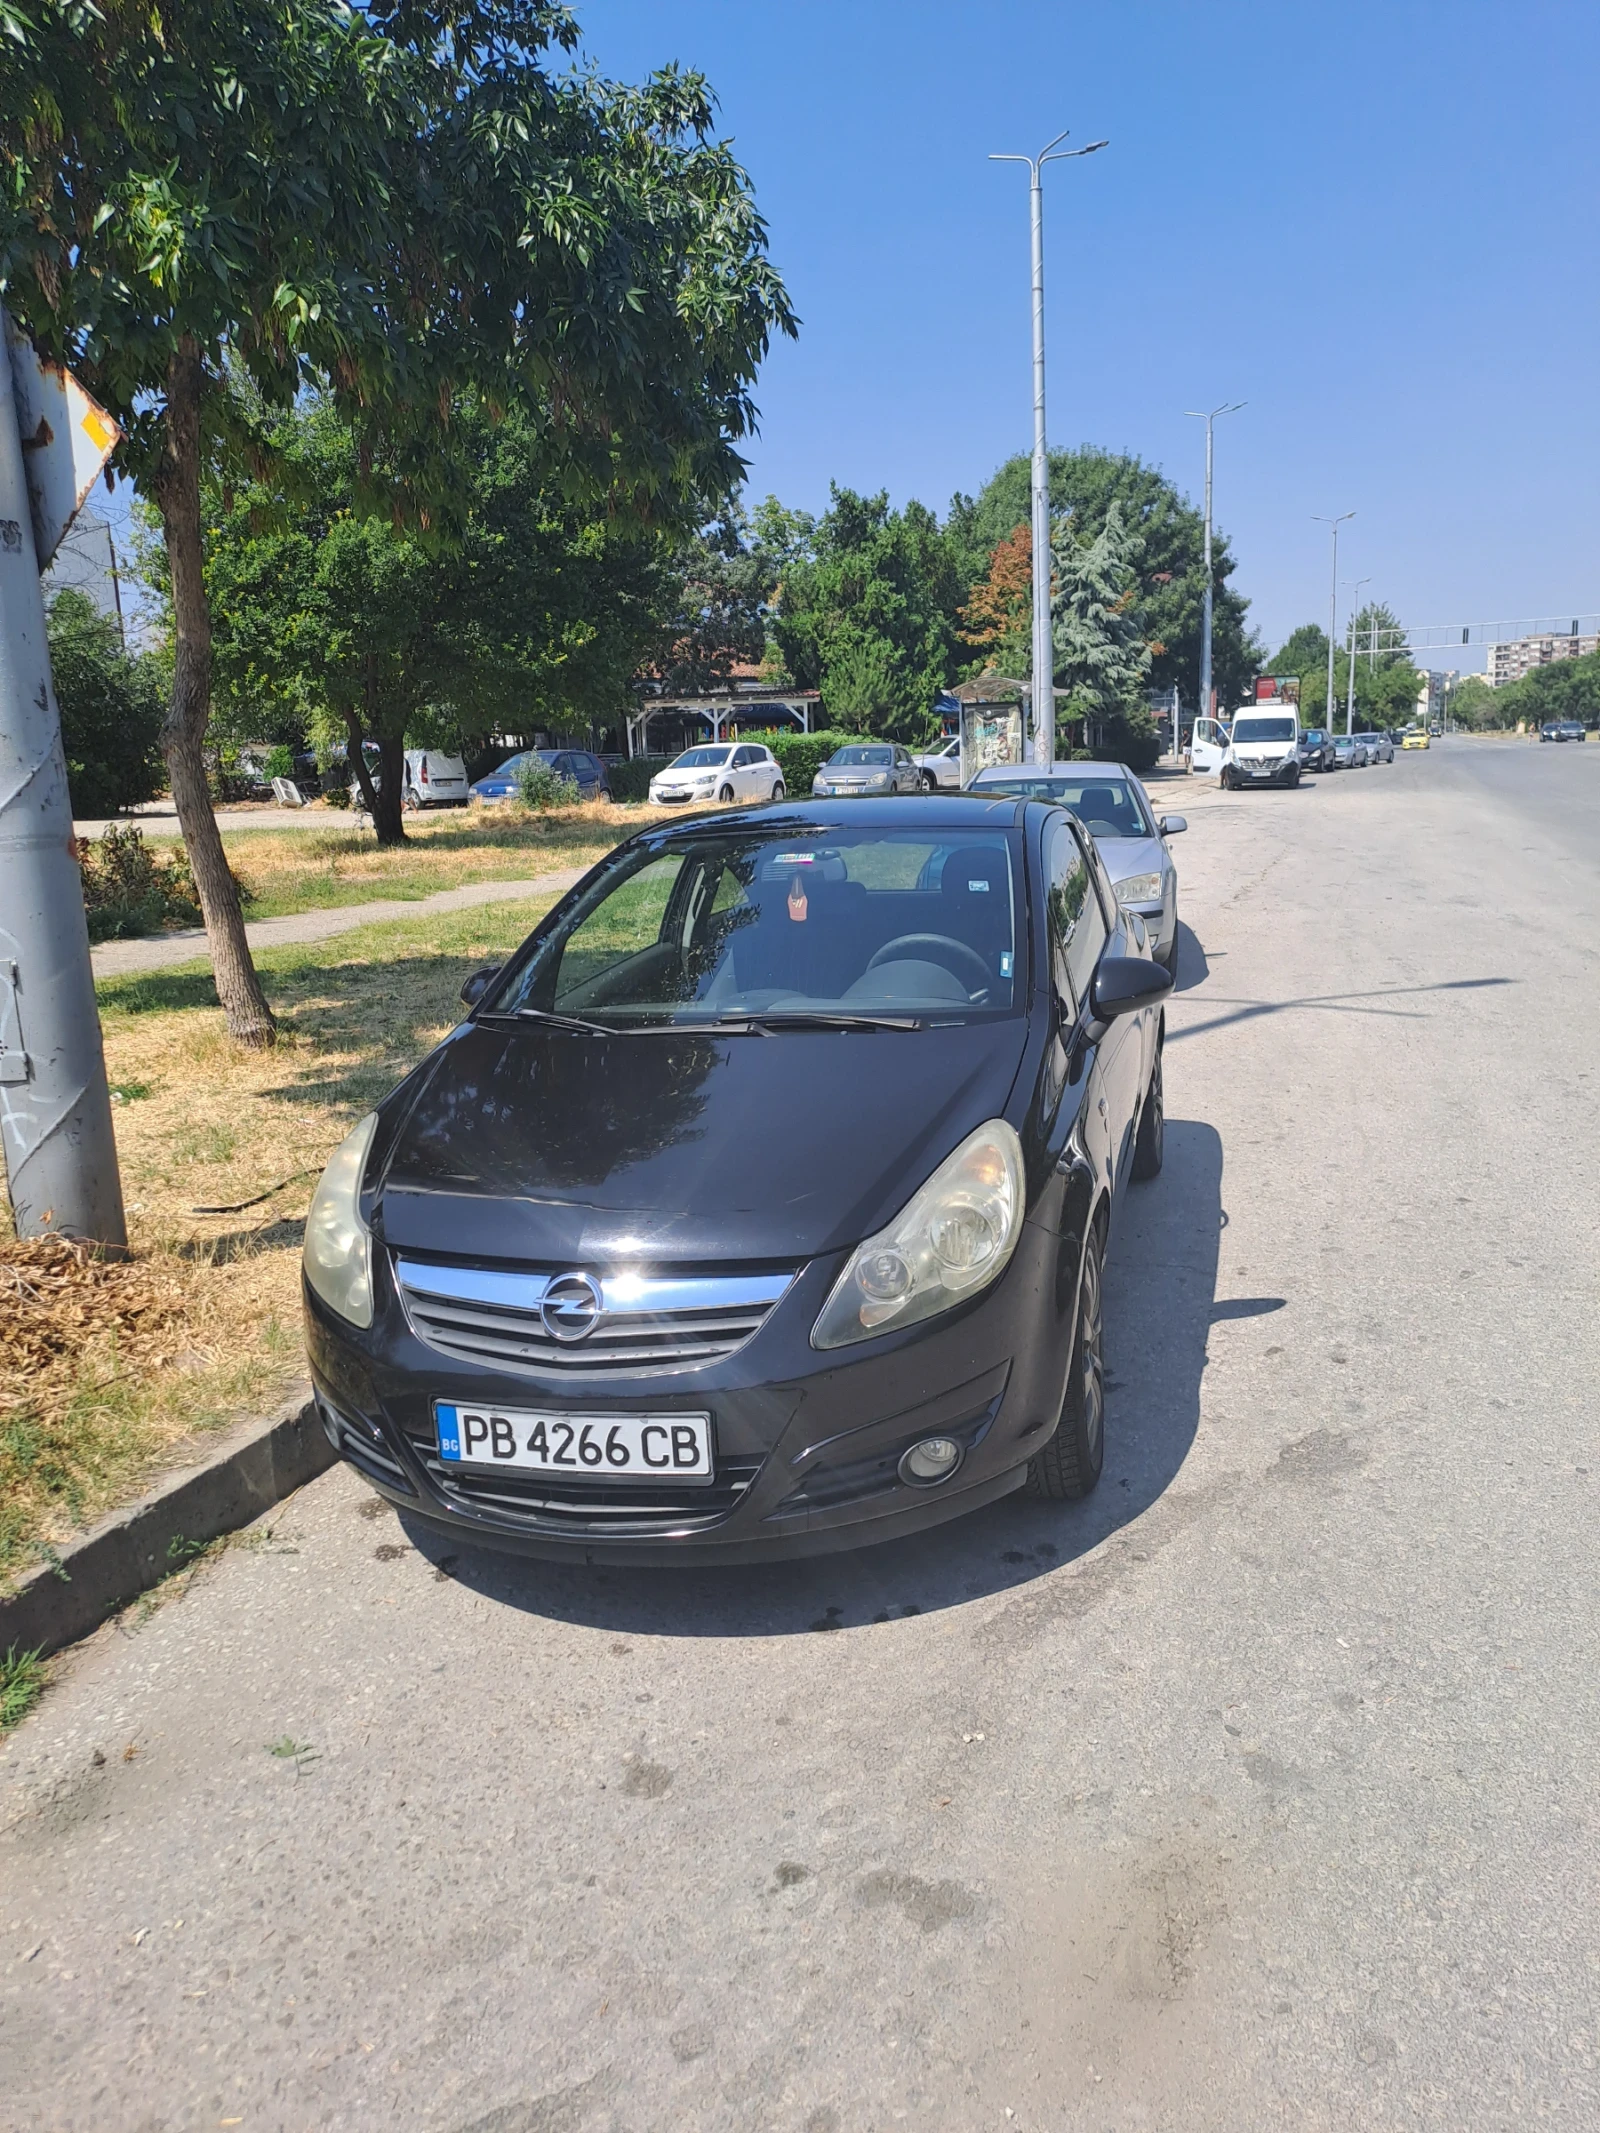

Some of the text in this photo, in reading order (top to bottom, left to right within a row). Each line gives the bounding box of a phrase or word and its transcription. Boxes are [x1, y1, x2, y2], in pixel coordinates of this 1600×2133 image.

[442, 1438, 459, 1451] BG
[462, 1414, 700, 1468] PB 4266 CB
